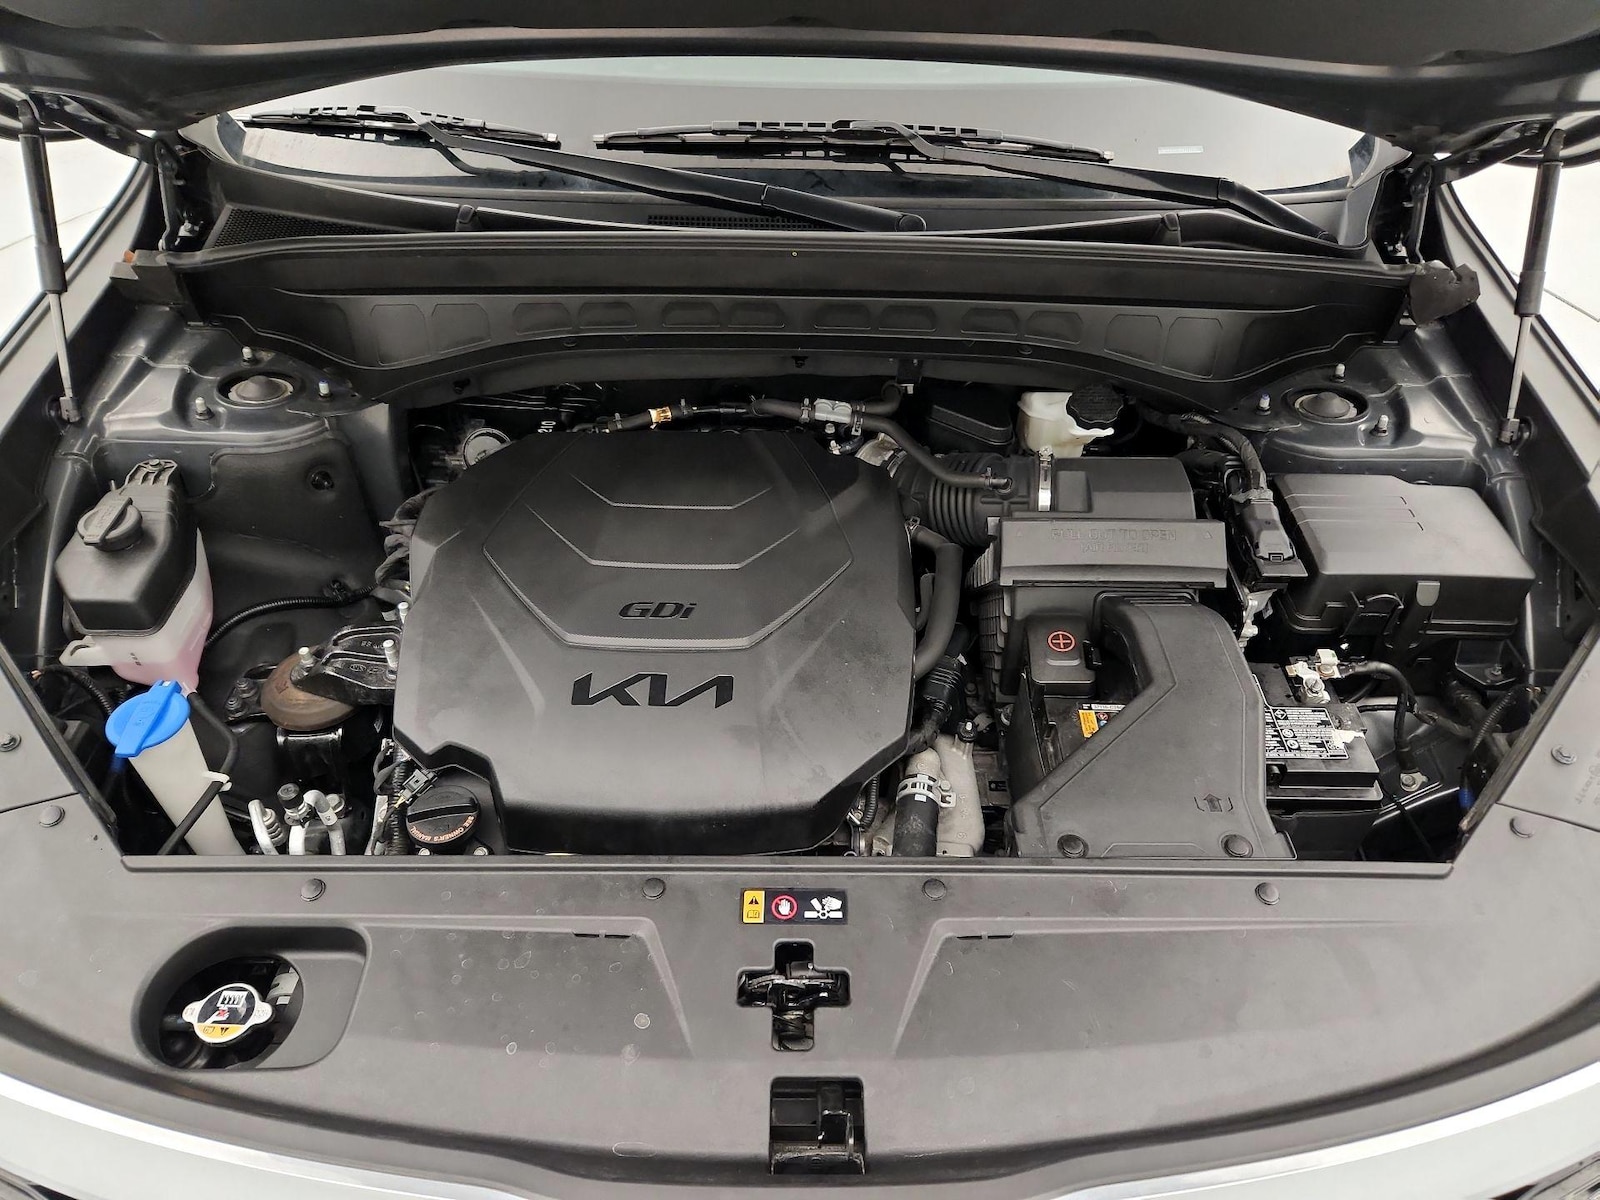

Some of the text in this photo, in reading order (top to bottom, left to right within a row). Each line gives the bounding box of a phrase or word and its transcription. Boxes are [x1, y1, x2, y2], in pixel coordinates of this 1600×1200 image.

[1088, 528, 1116, 540] OUT
[1119, 528, 1138, 540] TO
[1142, 528, 1177, 541] OPEN
[618, 601, 697, 619] GDi
[571, 671, 735, 709] KIA
[463, 815, 475, 828] SEE
[410, 825, 432, 841] MANUAL
